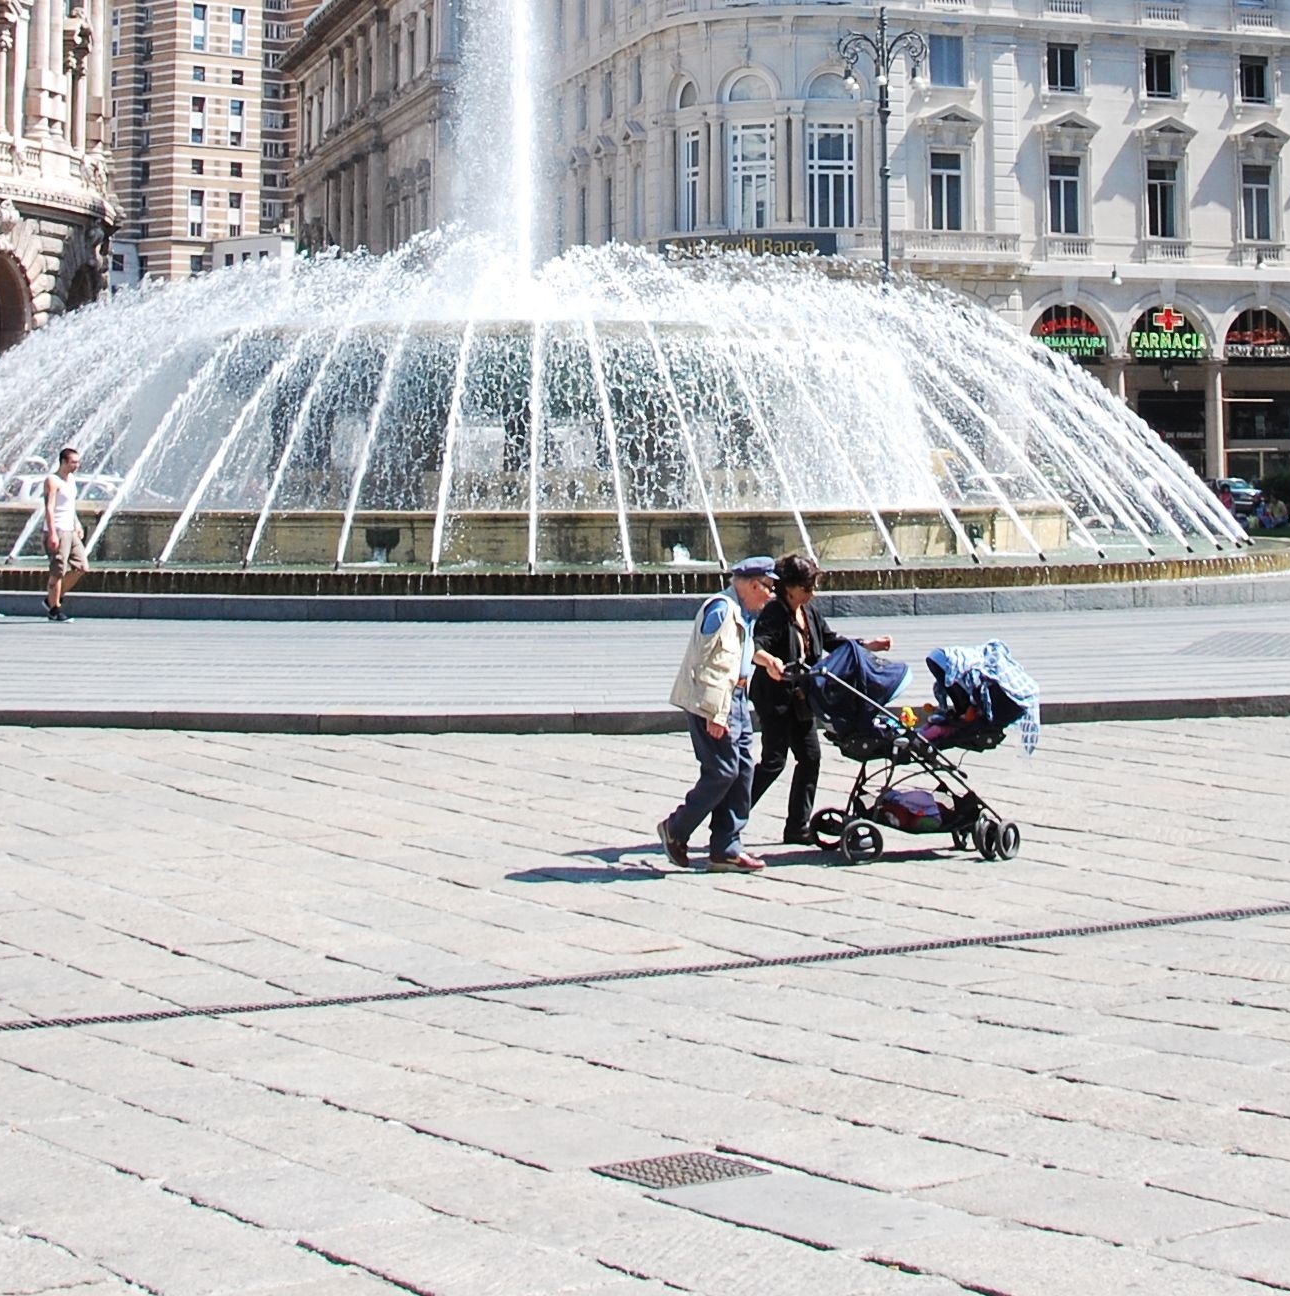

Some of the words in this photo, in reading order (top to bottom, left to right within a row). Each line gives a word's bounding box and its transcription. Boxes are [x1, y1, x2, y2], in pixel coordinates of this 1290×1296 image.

[761, 238, 815, 254] Banca
[1130, 331, 1207, 350] FARMACIA
[1135, 349, 1203, 359] OMEOPATIA
